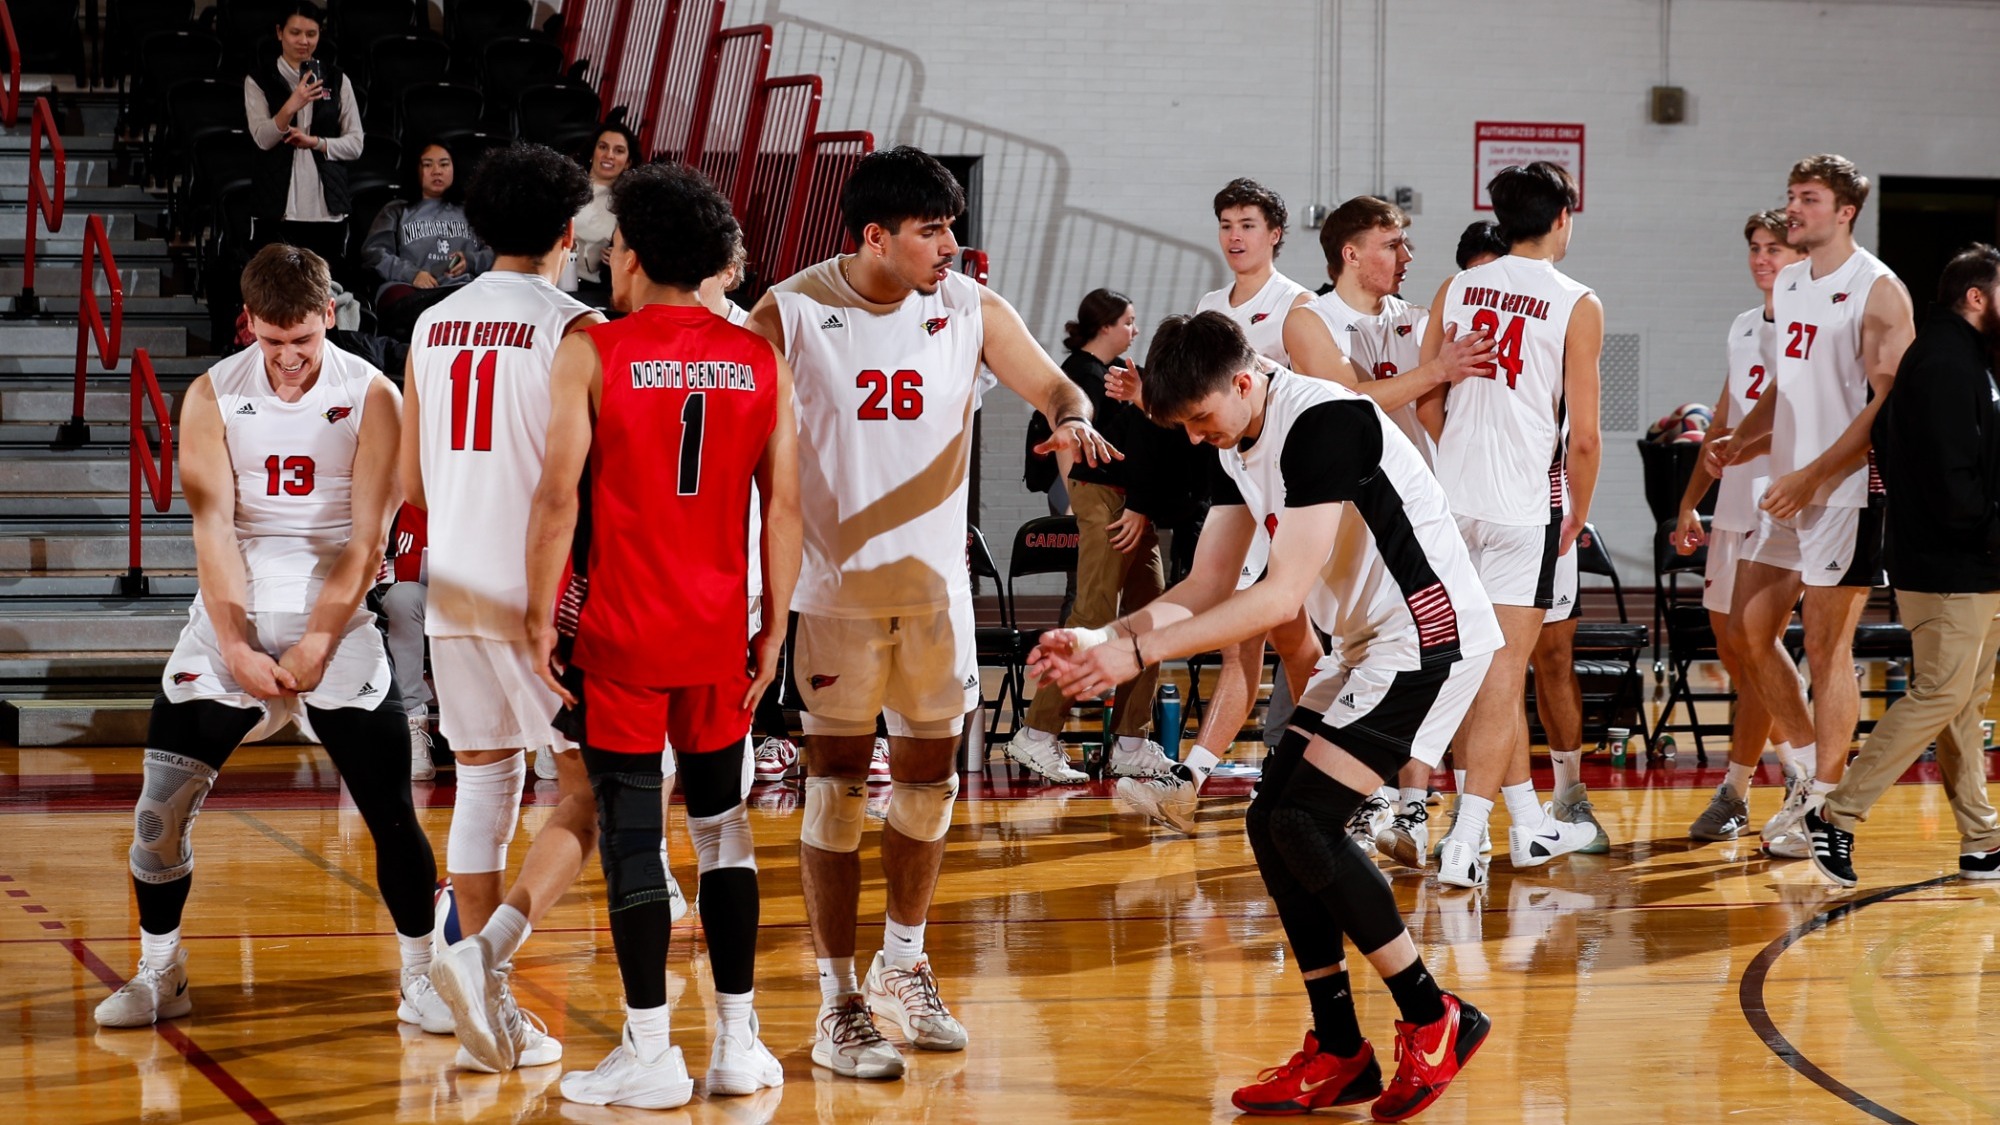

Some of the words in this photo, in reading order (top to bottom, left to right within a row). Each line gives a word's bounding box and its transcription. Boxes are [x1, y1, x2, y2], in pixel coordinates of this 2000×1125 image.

[1479, 126, 1536, 138] AUTHORIZED
[1538, 128, 1556, 138] USE
[1558, 128, 1580, 139] ONLY
[1462, 286, 1501, 309] NORTH
[1501, 292, 1550, 321] CENTRAL
[427, 321, 472, 348] NORTH
[472, 321, 536, 349] CENTRAL
[1471, 308, 1526, 390] 24
[1785, 321, 1818, 360] 27
[630, 360, 683, 389] NORTH
[685, 361, 756, 392] CENTRAL
[856, 369, 923, 420] 26
[450, 350, 498, 451] 11
[677, 391, 706, 496] 1
[264, 455, 315, 496] 13
